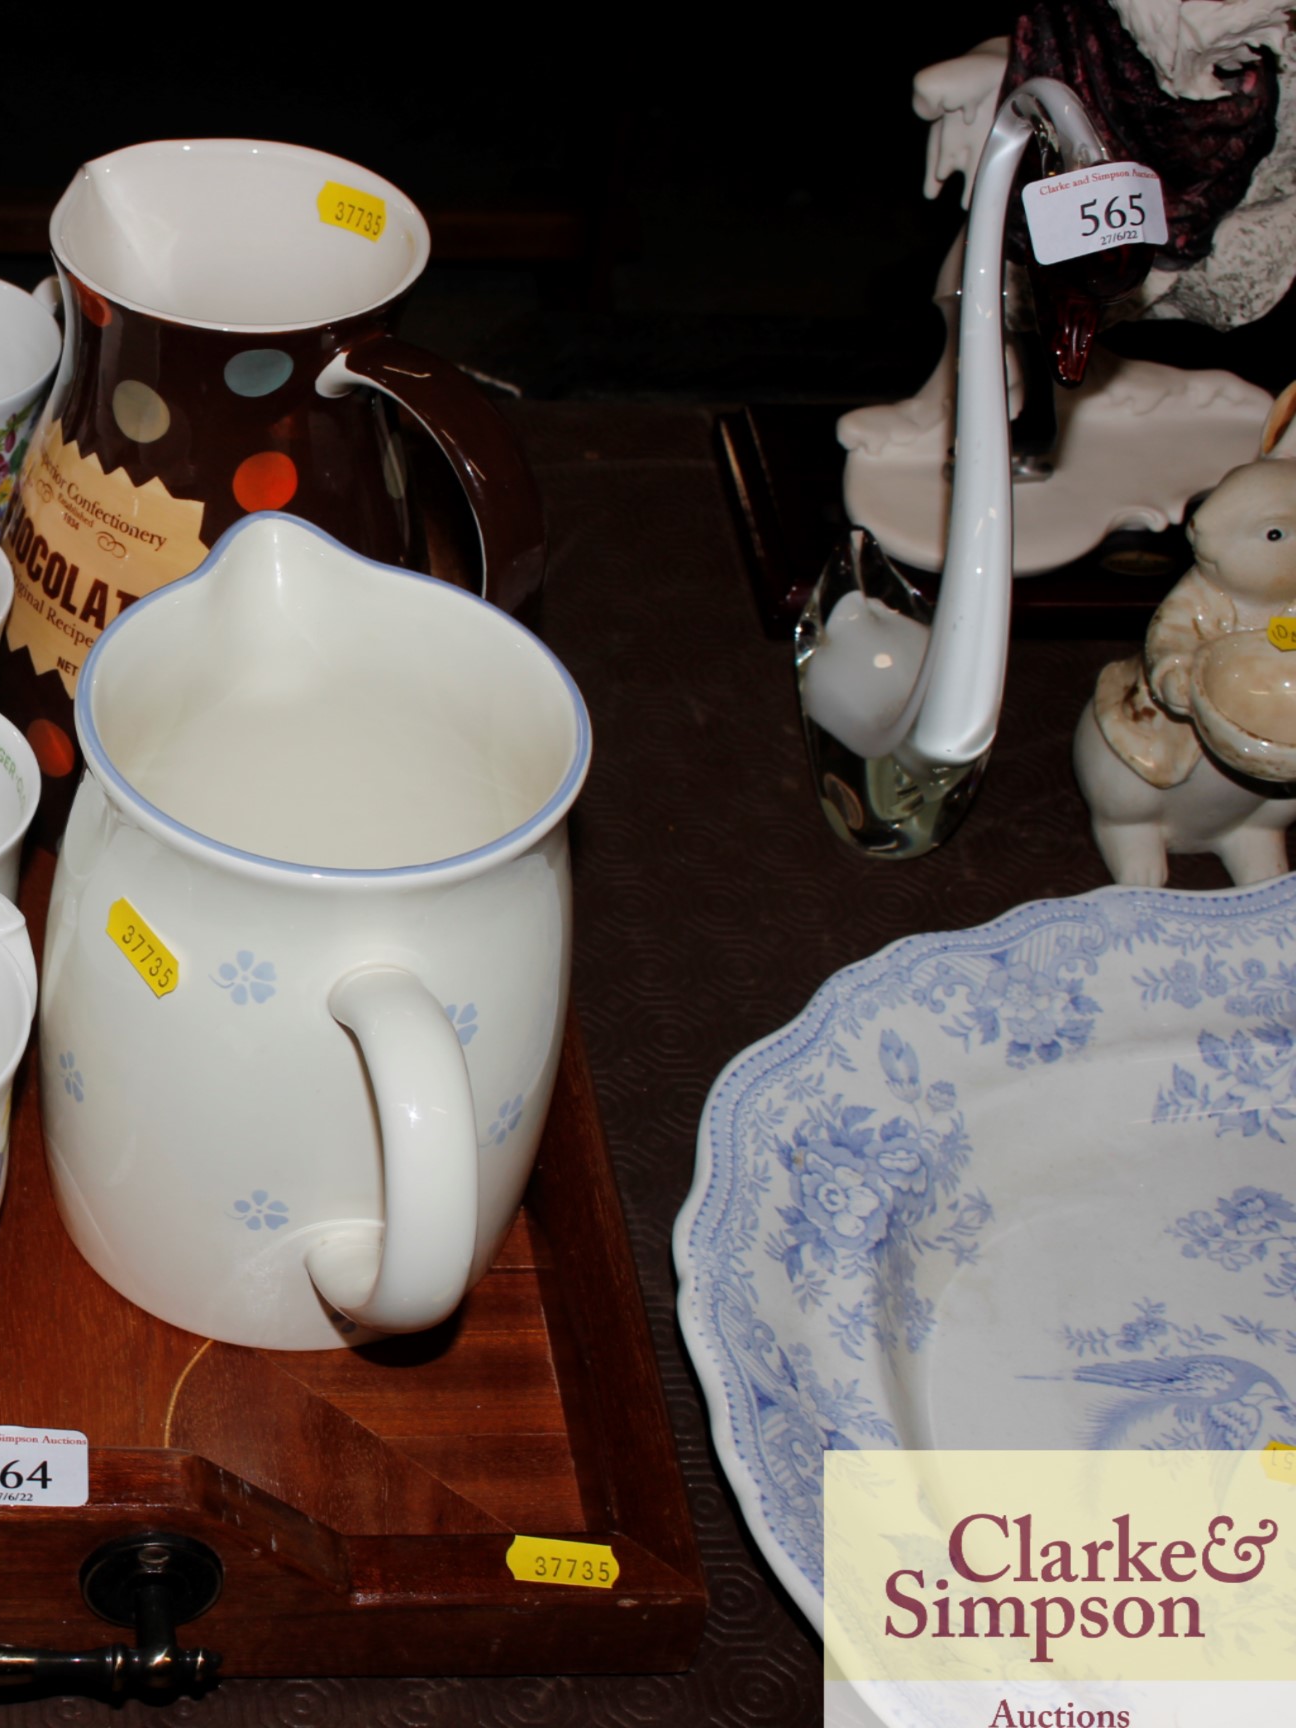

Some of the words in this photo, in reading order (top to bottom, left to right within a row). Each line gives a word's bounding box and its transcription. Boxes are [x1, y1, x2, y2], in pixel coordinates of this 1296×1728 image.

[1039, 182, 1070, 196] Clarke
[1073, 176, 1090, 188] and
[1091, 169, 1130, 183] Simpson
[334, 200, 383, 236] 37735
[1080, 193, 1146, 237] 565
[1100, 230, 1138, 246] 27/6/22
[67, 482, 167, 552] Confectionery
[45, 606, 95, 649] Recipe
[56, 656, 80, 677] NET
[121, 924, 174, 988] 37735
[42, 1435, 87, 1446] Auctions
[534, 1556, 610, 1582] 37735
